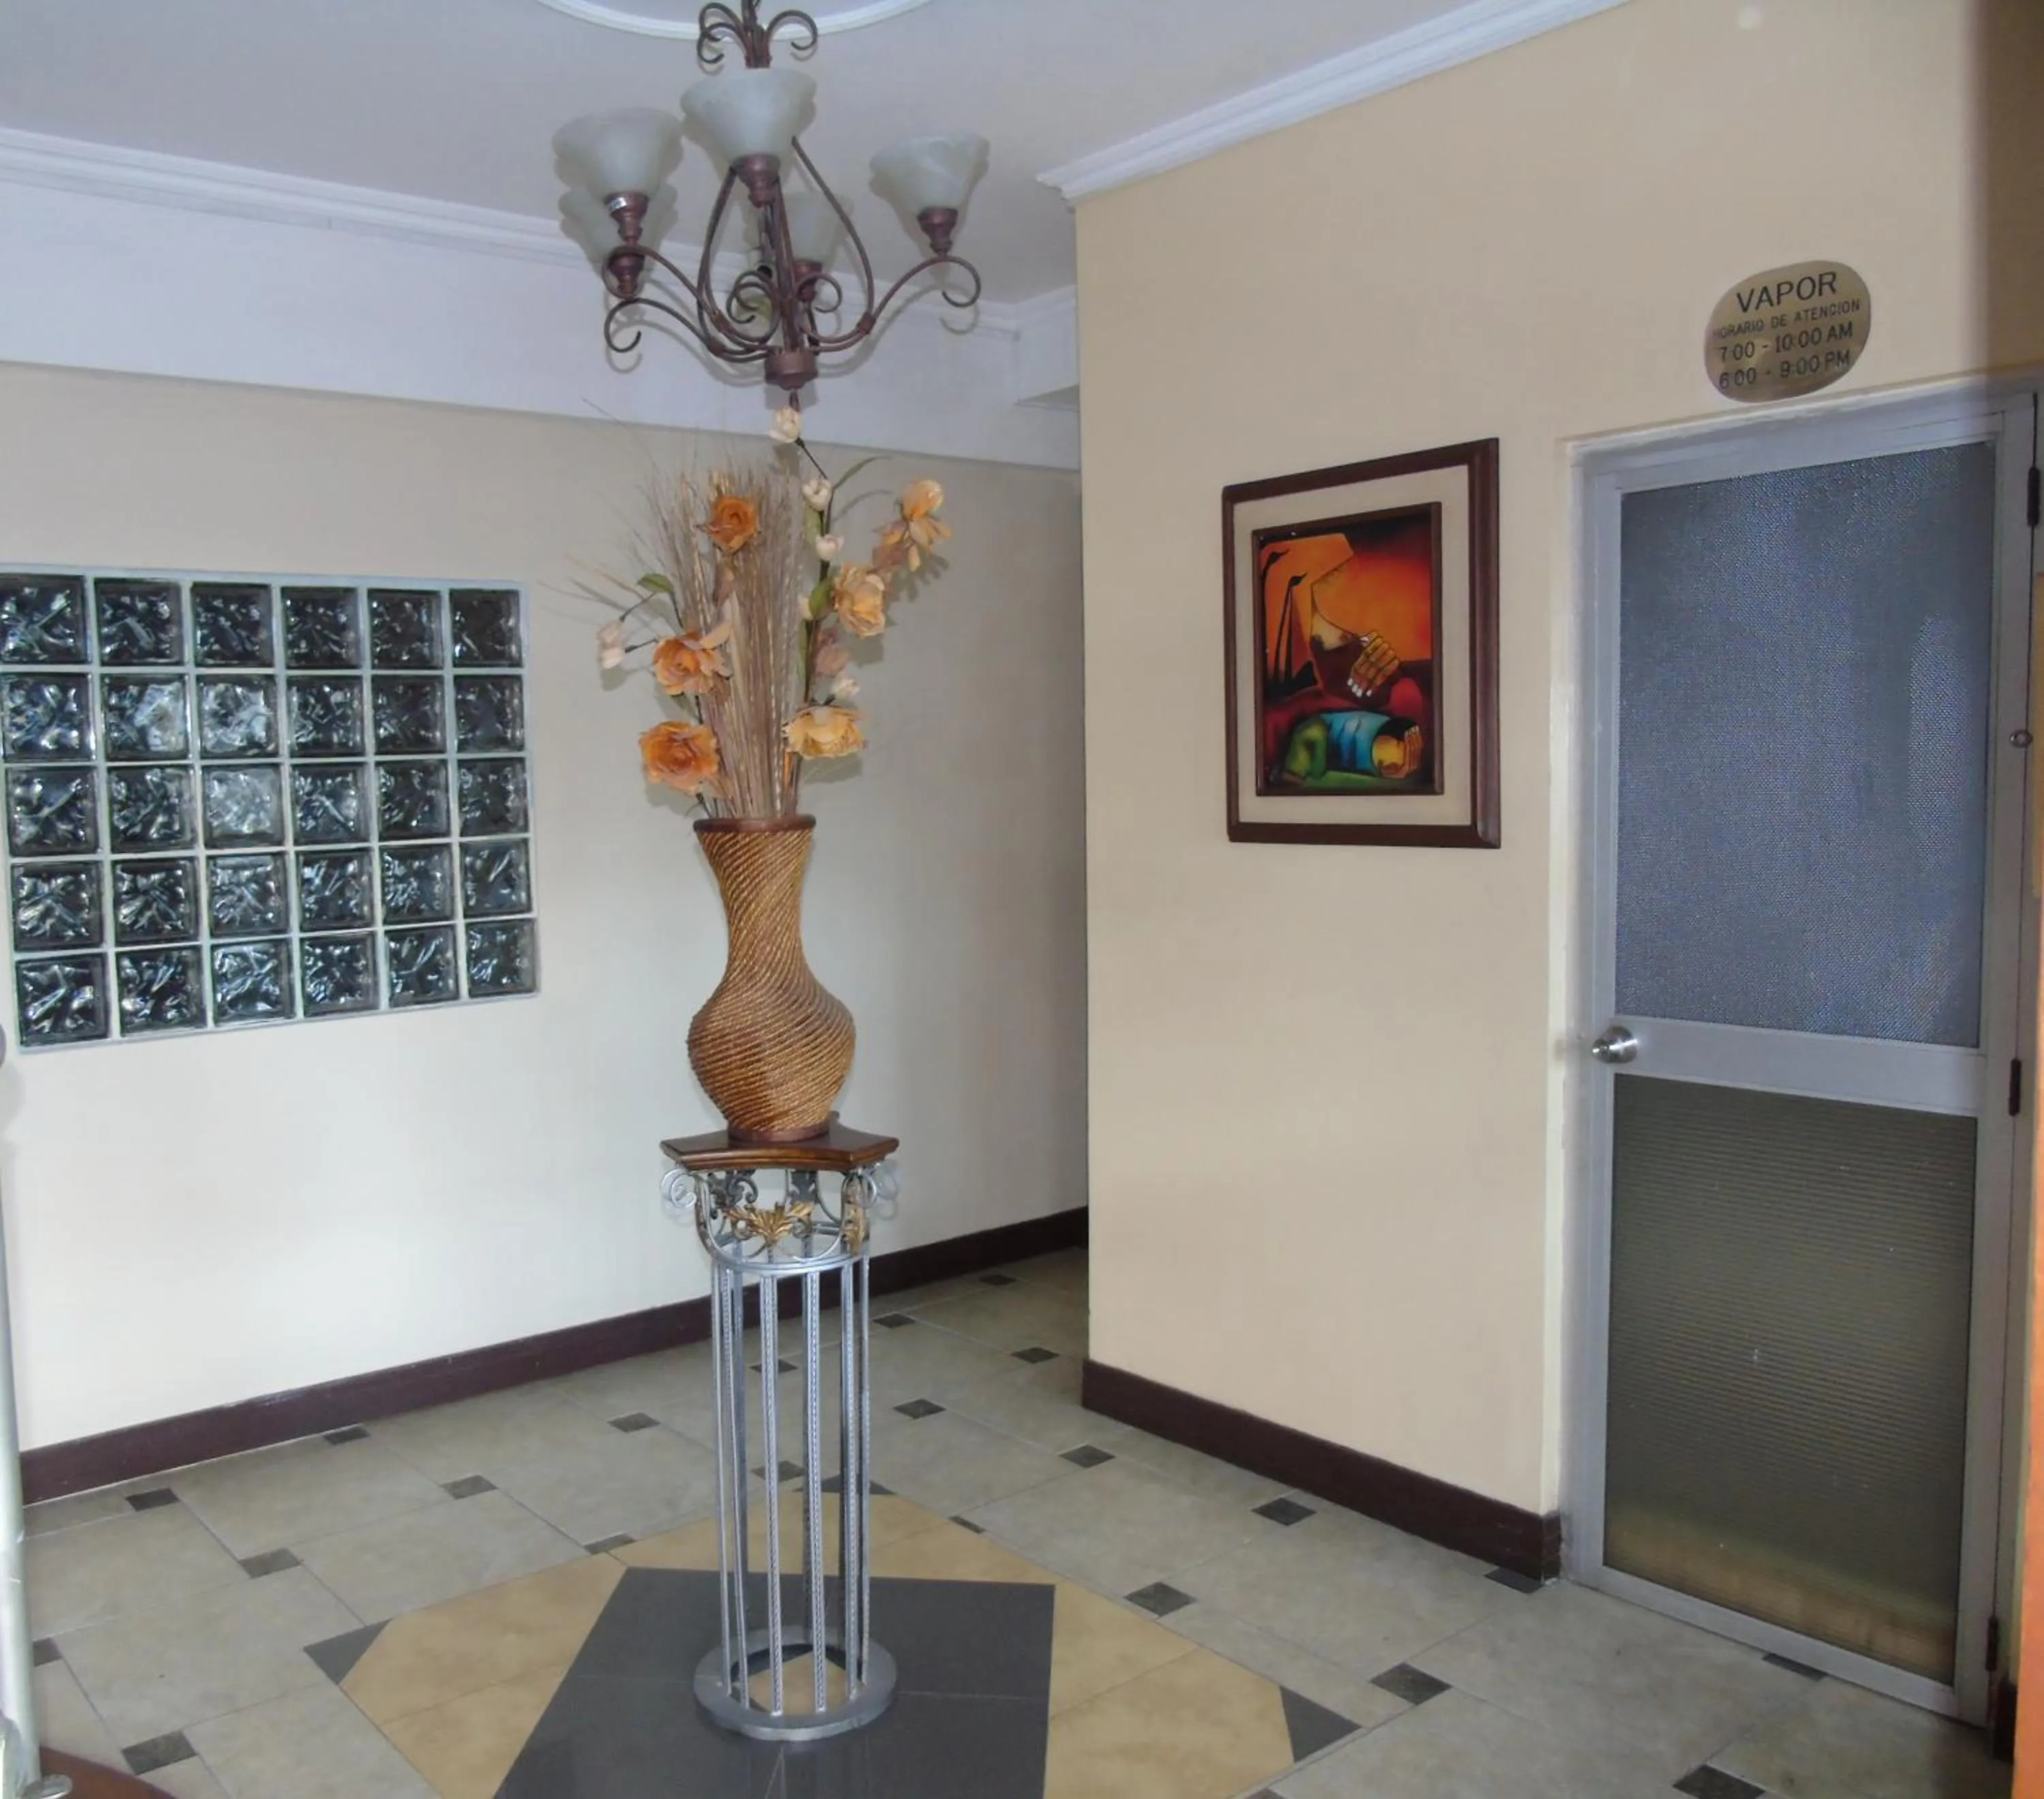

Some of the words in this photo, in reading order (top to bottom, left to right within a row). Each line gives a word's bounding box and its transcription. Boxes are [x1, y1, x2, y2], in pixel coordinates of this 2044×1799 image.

[1737, 271, 1837, 313] VAPOR
[1771, 314, 1788, 329] DE
[1794, 298, 1861, 322] ATENCION
[1827, 321, 1853, 343] AM
[1825, 350, 1851, 371] PM
